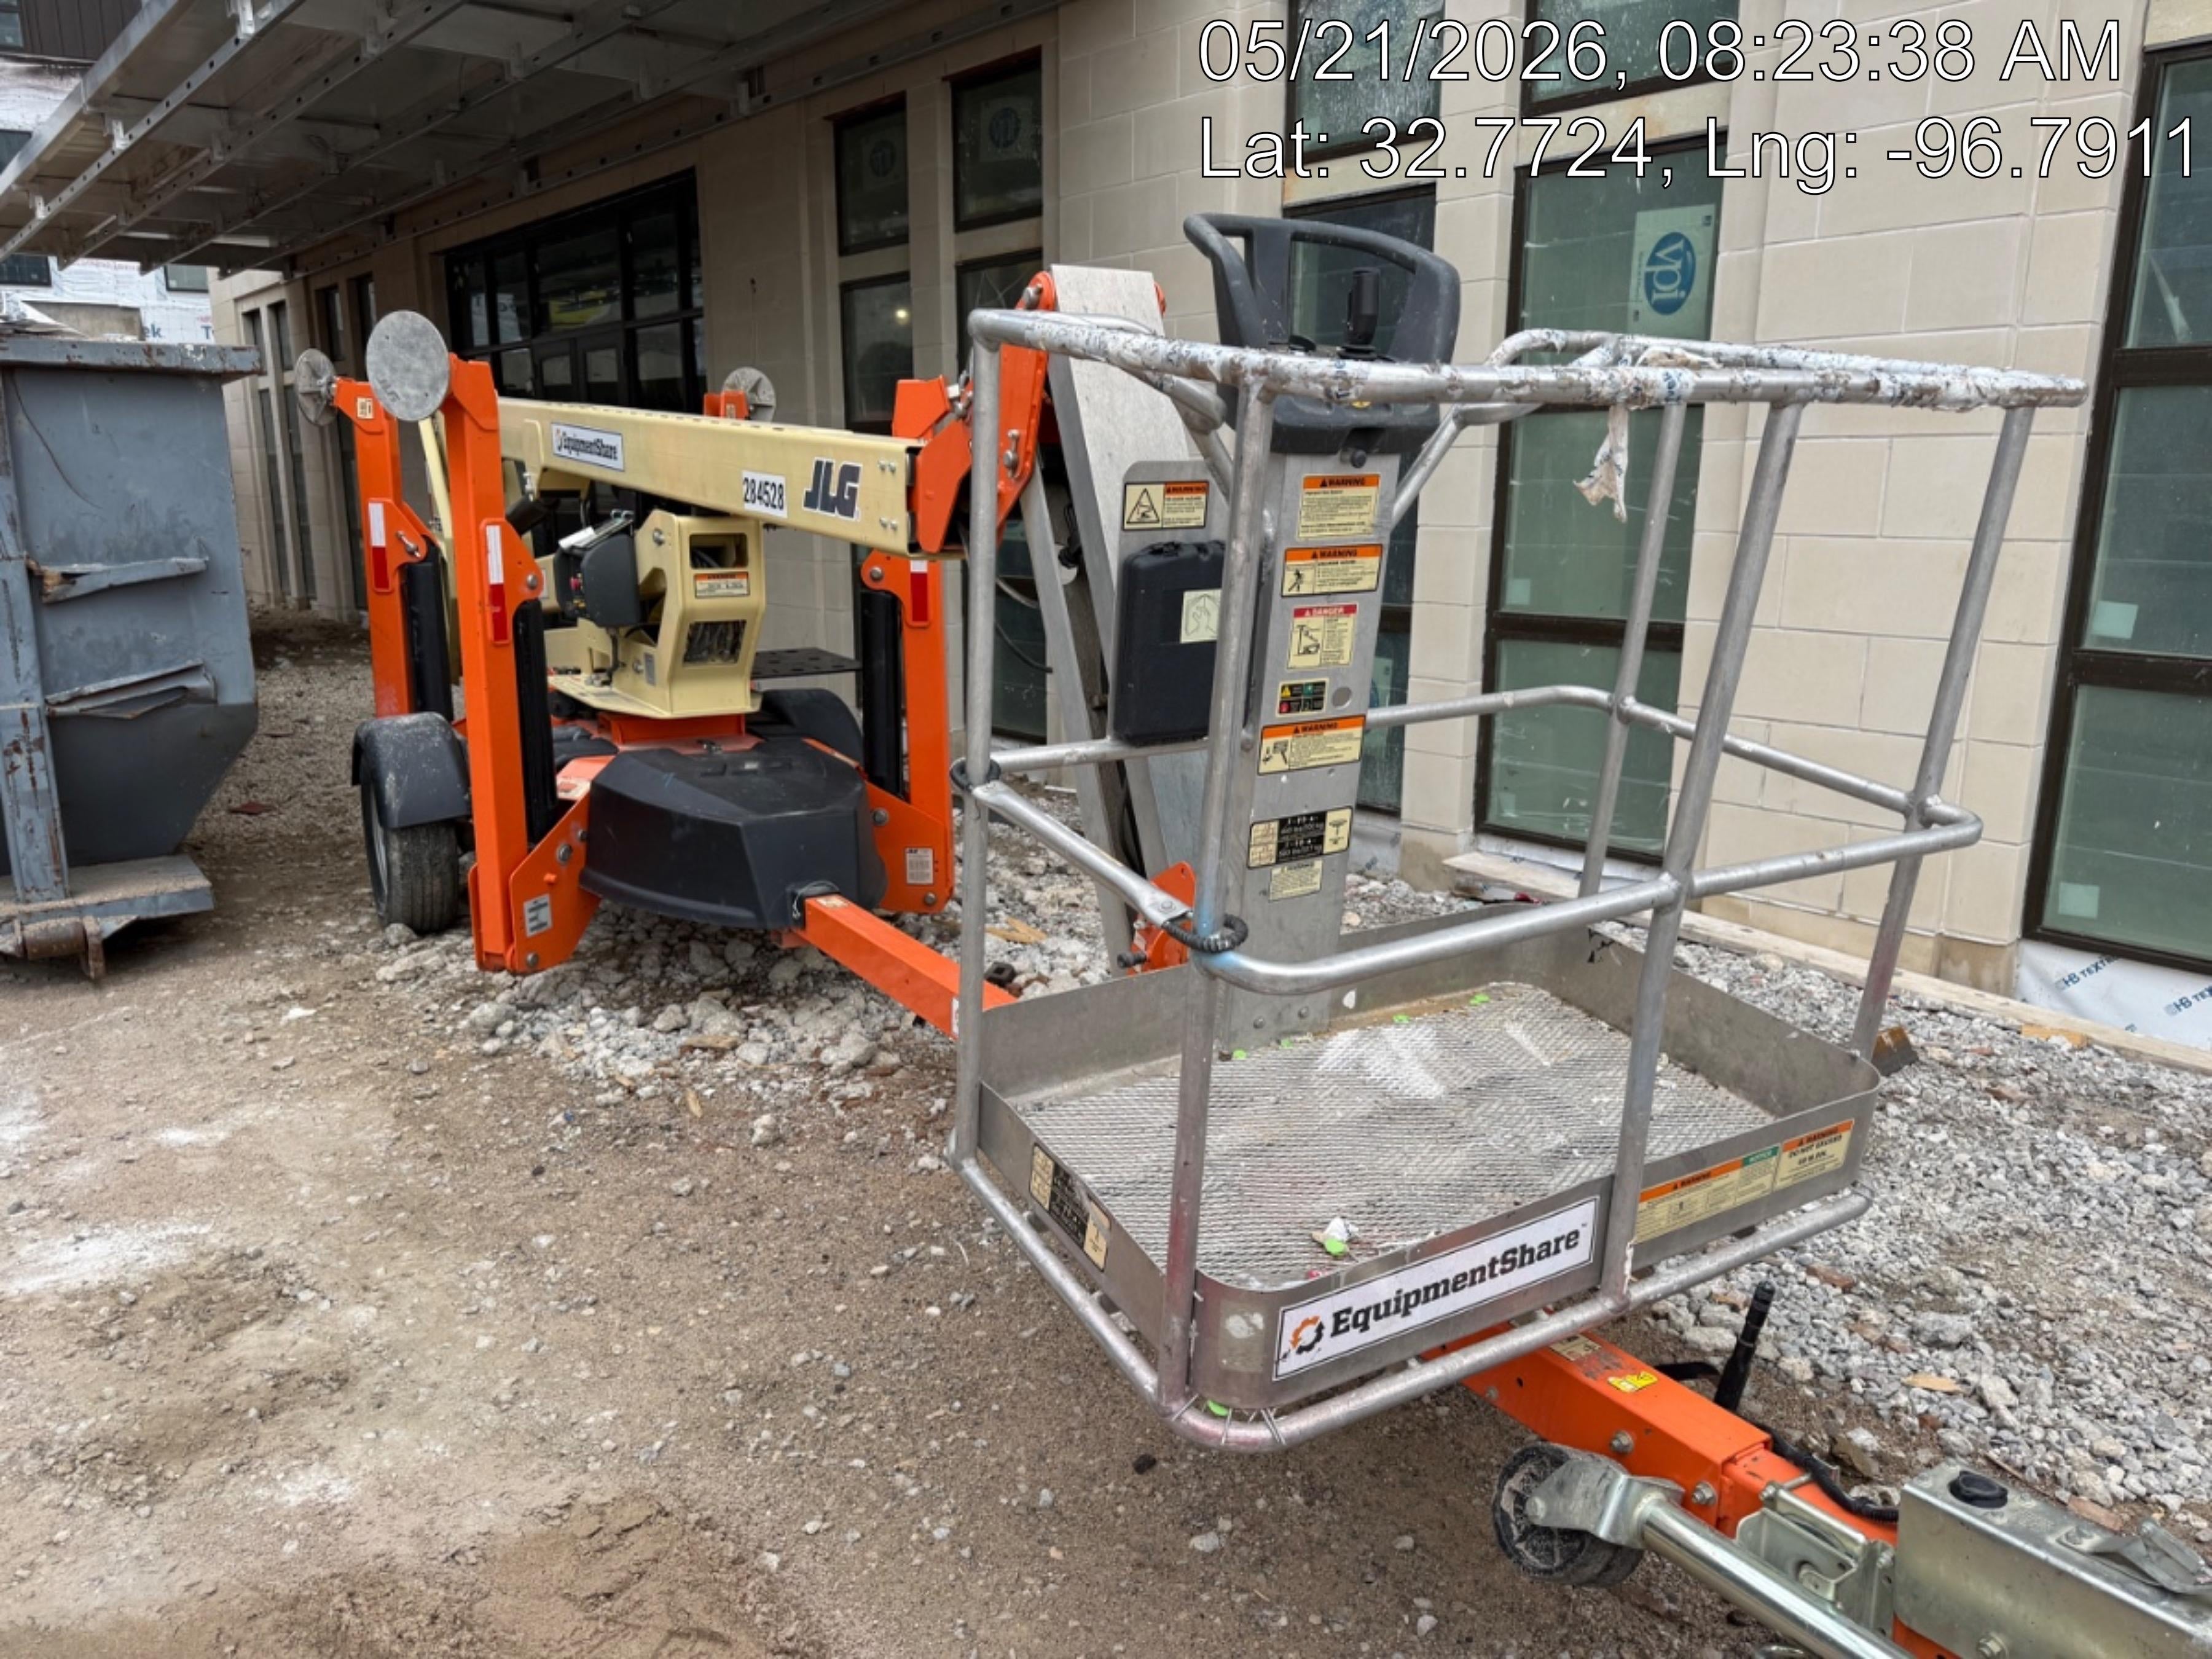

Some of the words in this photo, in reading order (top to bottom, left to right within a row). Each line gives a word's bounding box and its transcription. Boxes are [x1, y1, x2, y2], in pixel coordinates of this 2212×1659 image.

[1645, 238, 1686, 305] vpi
[743, 477, 784, 510] 284528
[803, 460, 862, 519] JLG
[1319, 548, 1357, 558] WARNING
[1301, 722, 1338, 733] WARNING
[1329, 1228, 1581, 1337] EquipmentShare
